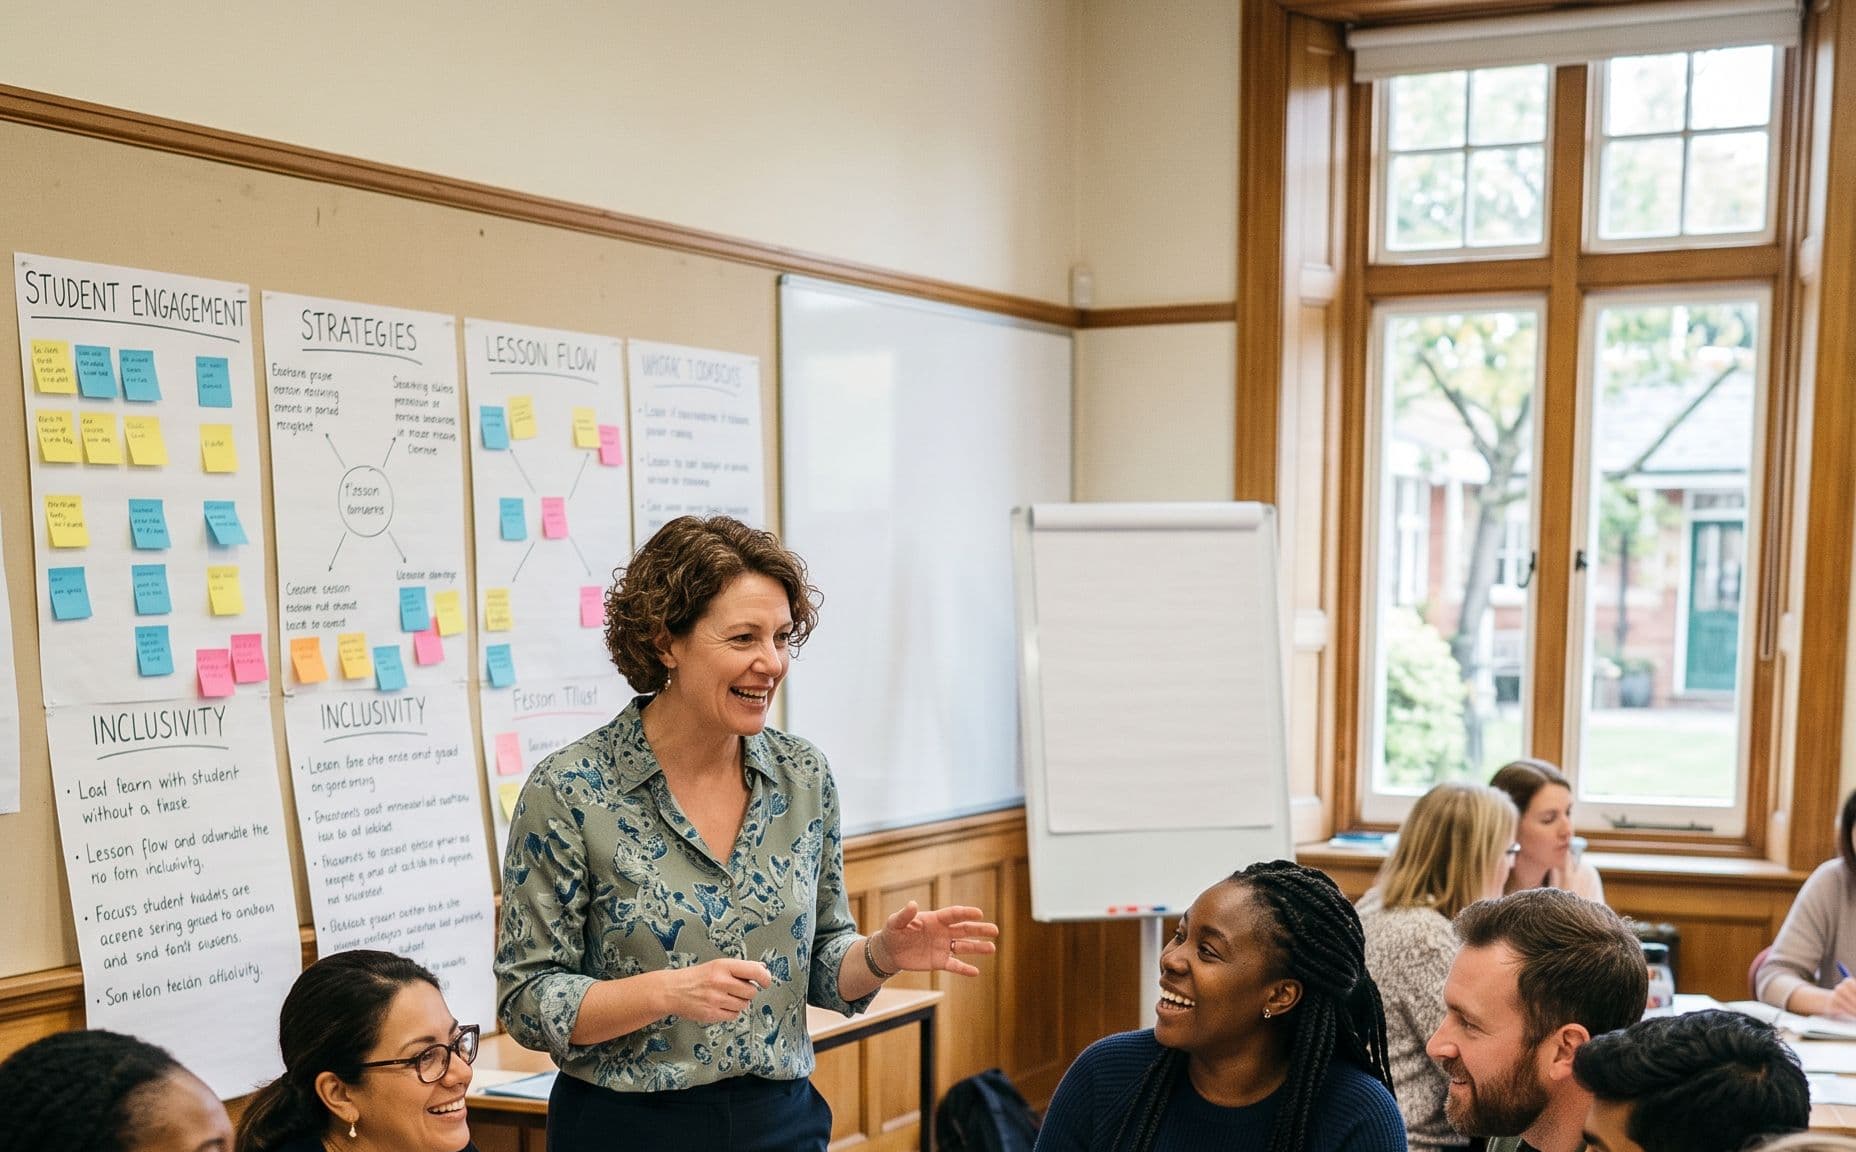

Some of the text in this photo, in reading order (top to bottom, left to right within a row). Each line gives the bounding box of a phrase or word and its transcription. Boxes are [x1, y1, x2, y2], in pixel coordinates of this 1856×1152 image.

[25, 270, 247, 327] STUDENT ENGAGEMENT
[301, 309, 417, 351] STRATEGIES
[486, 336, 597, 372] LESSON FLOW
[92, 705, 226, 745] INCLUSIVITY
[321, 697, 426, 730] INCLUSIVITY
[158, 771, 187, 789] with
[192, 765, 240, 786] student
[82, 802, 134, 824] without
[140, 804, 151, 815] a
[86, 843, 134, 864] Lesson
[142, 838, 168, 860] flow
[174, 833, 196, 849] and
[143, 893, 184, 914] student
[231, 884, 251, 897] are
[221, 908, 232, 921] to
[103, 952, 128, 970] and
